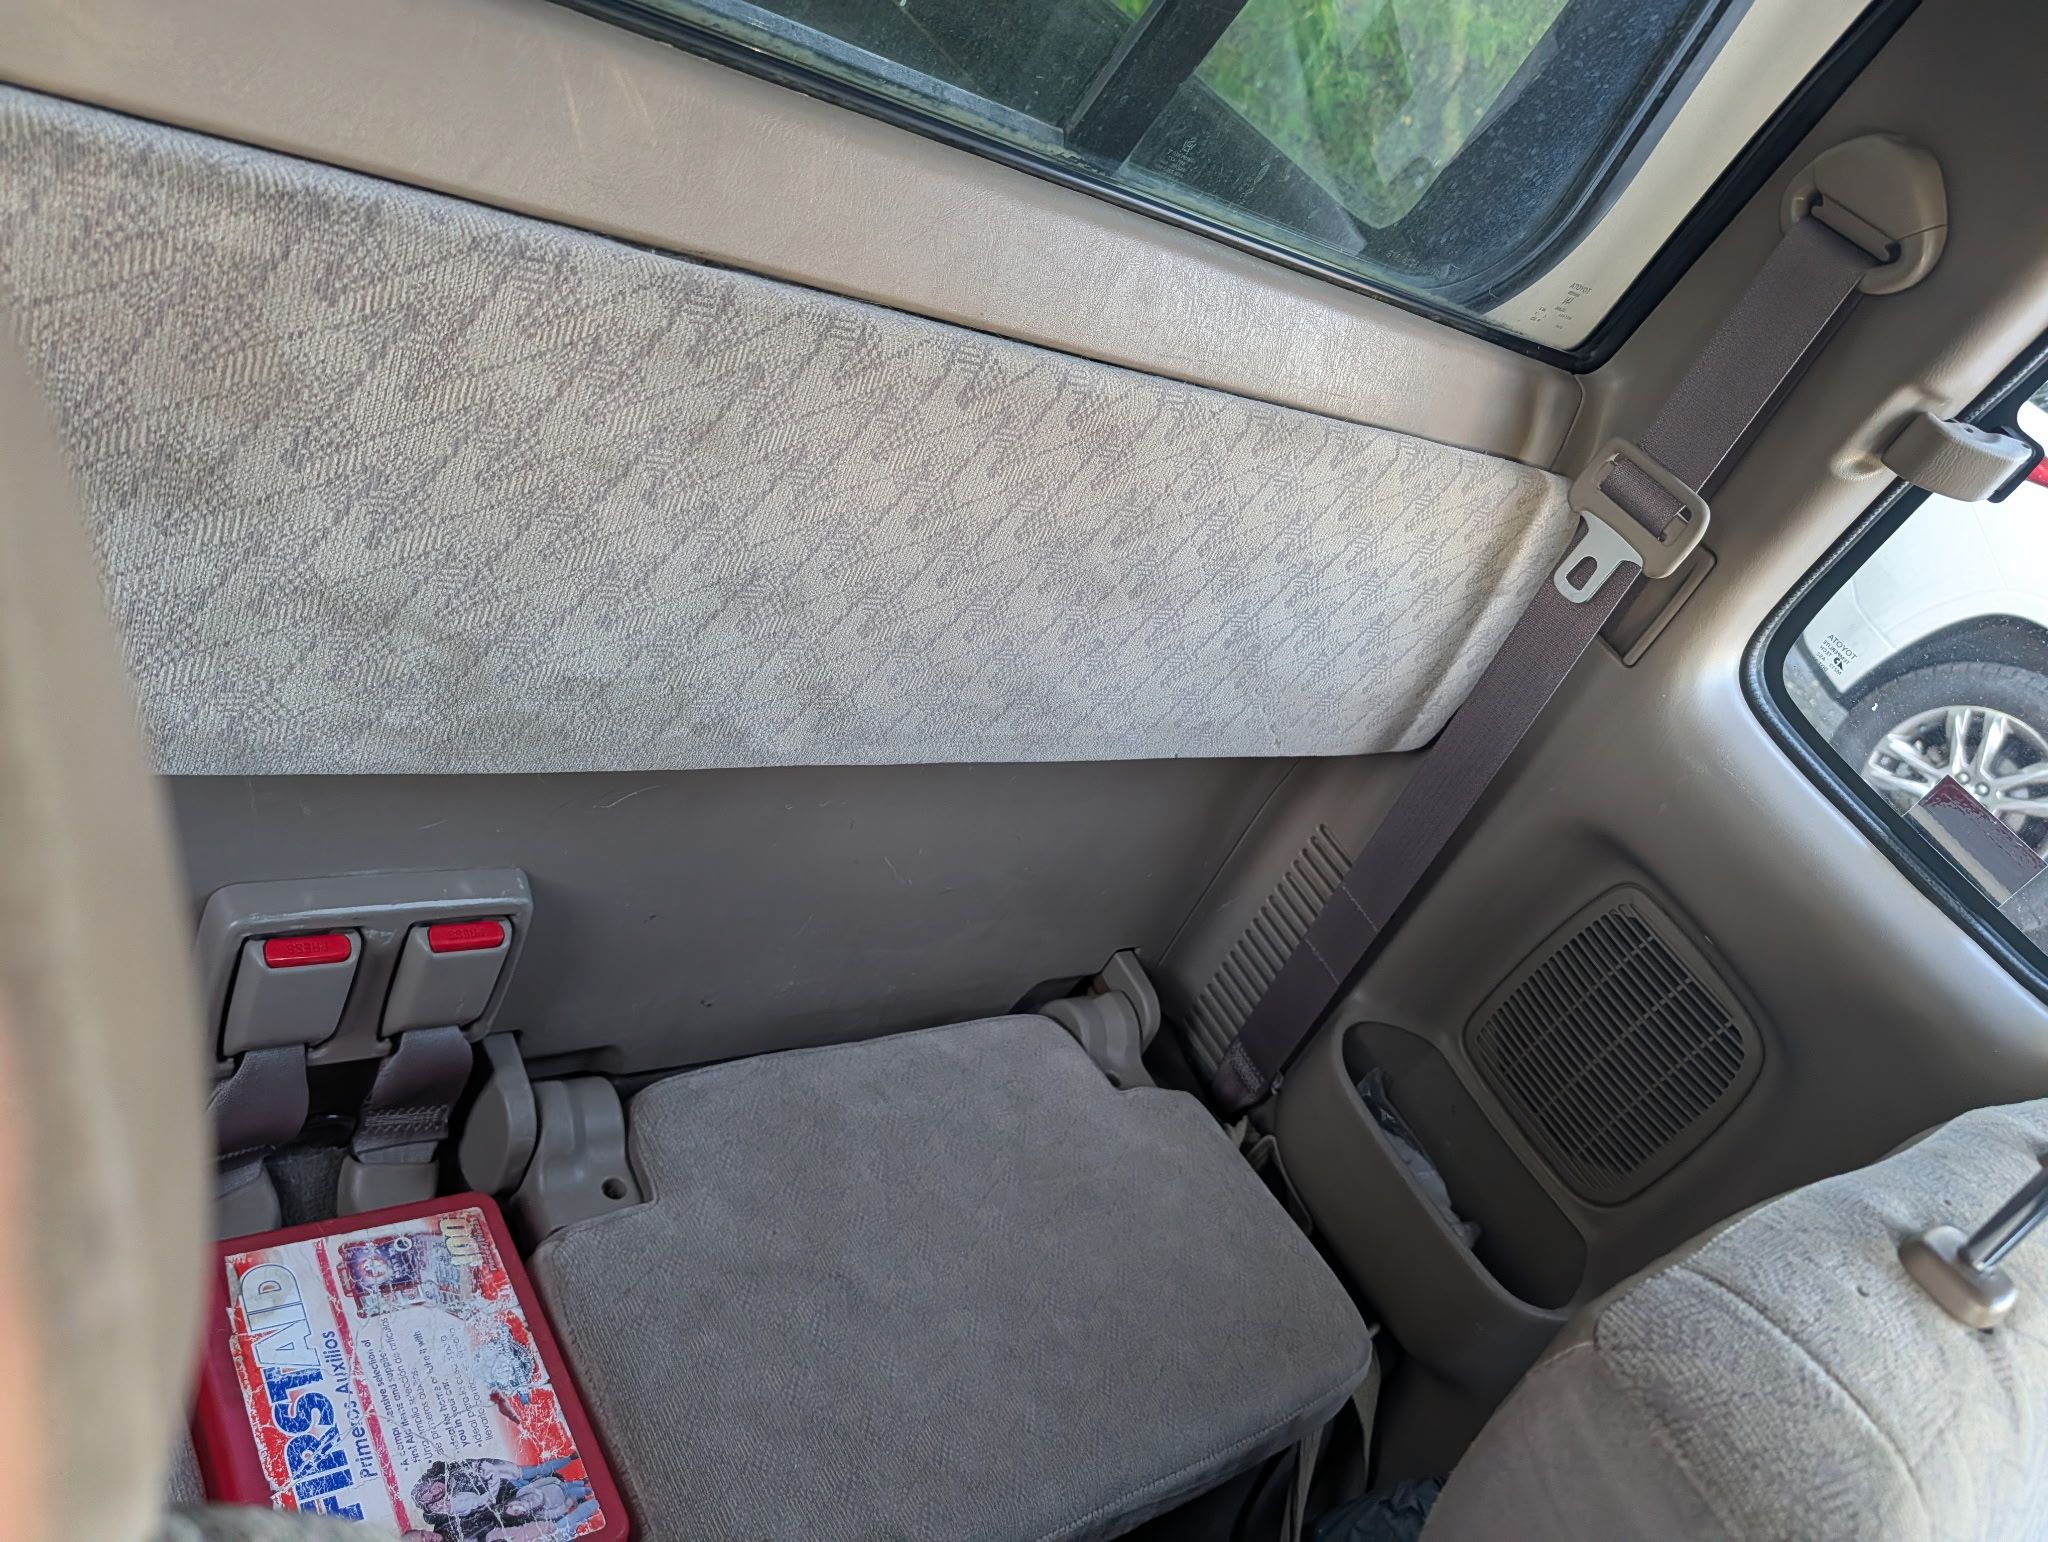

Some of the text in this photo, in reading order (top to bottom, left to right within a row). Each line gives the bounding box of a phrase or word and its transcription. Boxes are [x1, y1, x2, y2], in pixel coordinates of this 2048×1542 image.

[286, 940, 329, 955] PRESS
[437, 1216, 484, 1265] 100
[240, 1263, 321, 1366] AID
[411, 1329, 425, 1348] with
[390, 1350, 403, 1365] de
[360, 1337, 409, 1467] A comprensive selection of
[387, 1382, 401, 1402] and
[316, 1329, 379, 1480] Primeros Auxilios
[446, 1396, 461, 1418] your
[453, 1417, 463, 1428] in
[467, 1418, 483, 1444] Ideal
[402, 1427, 415, 1445] Aid
[456, 1428, 471, 1448] you
